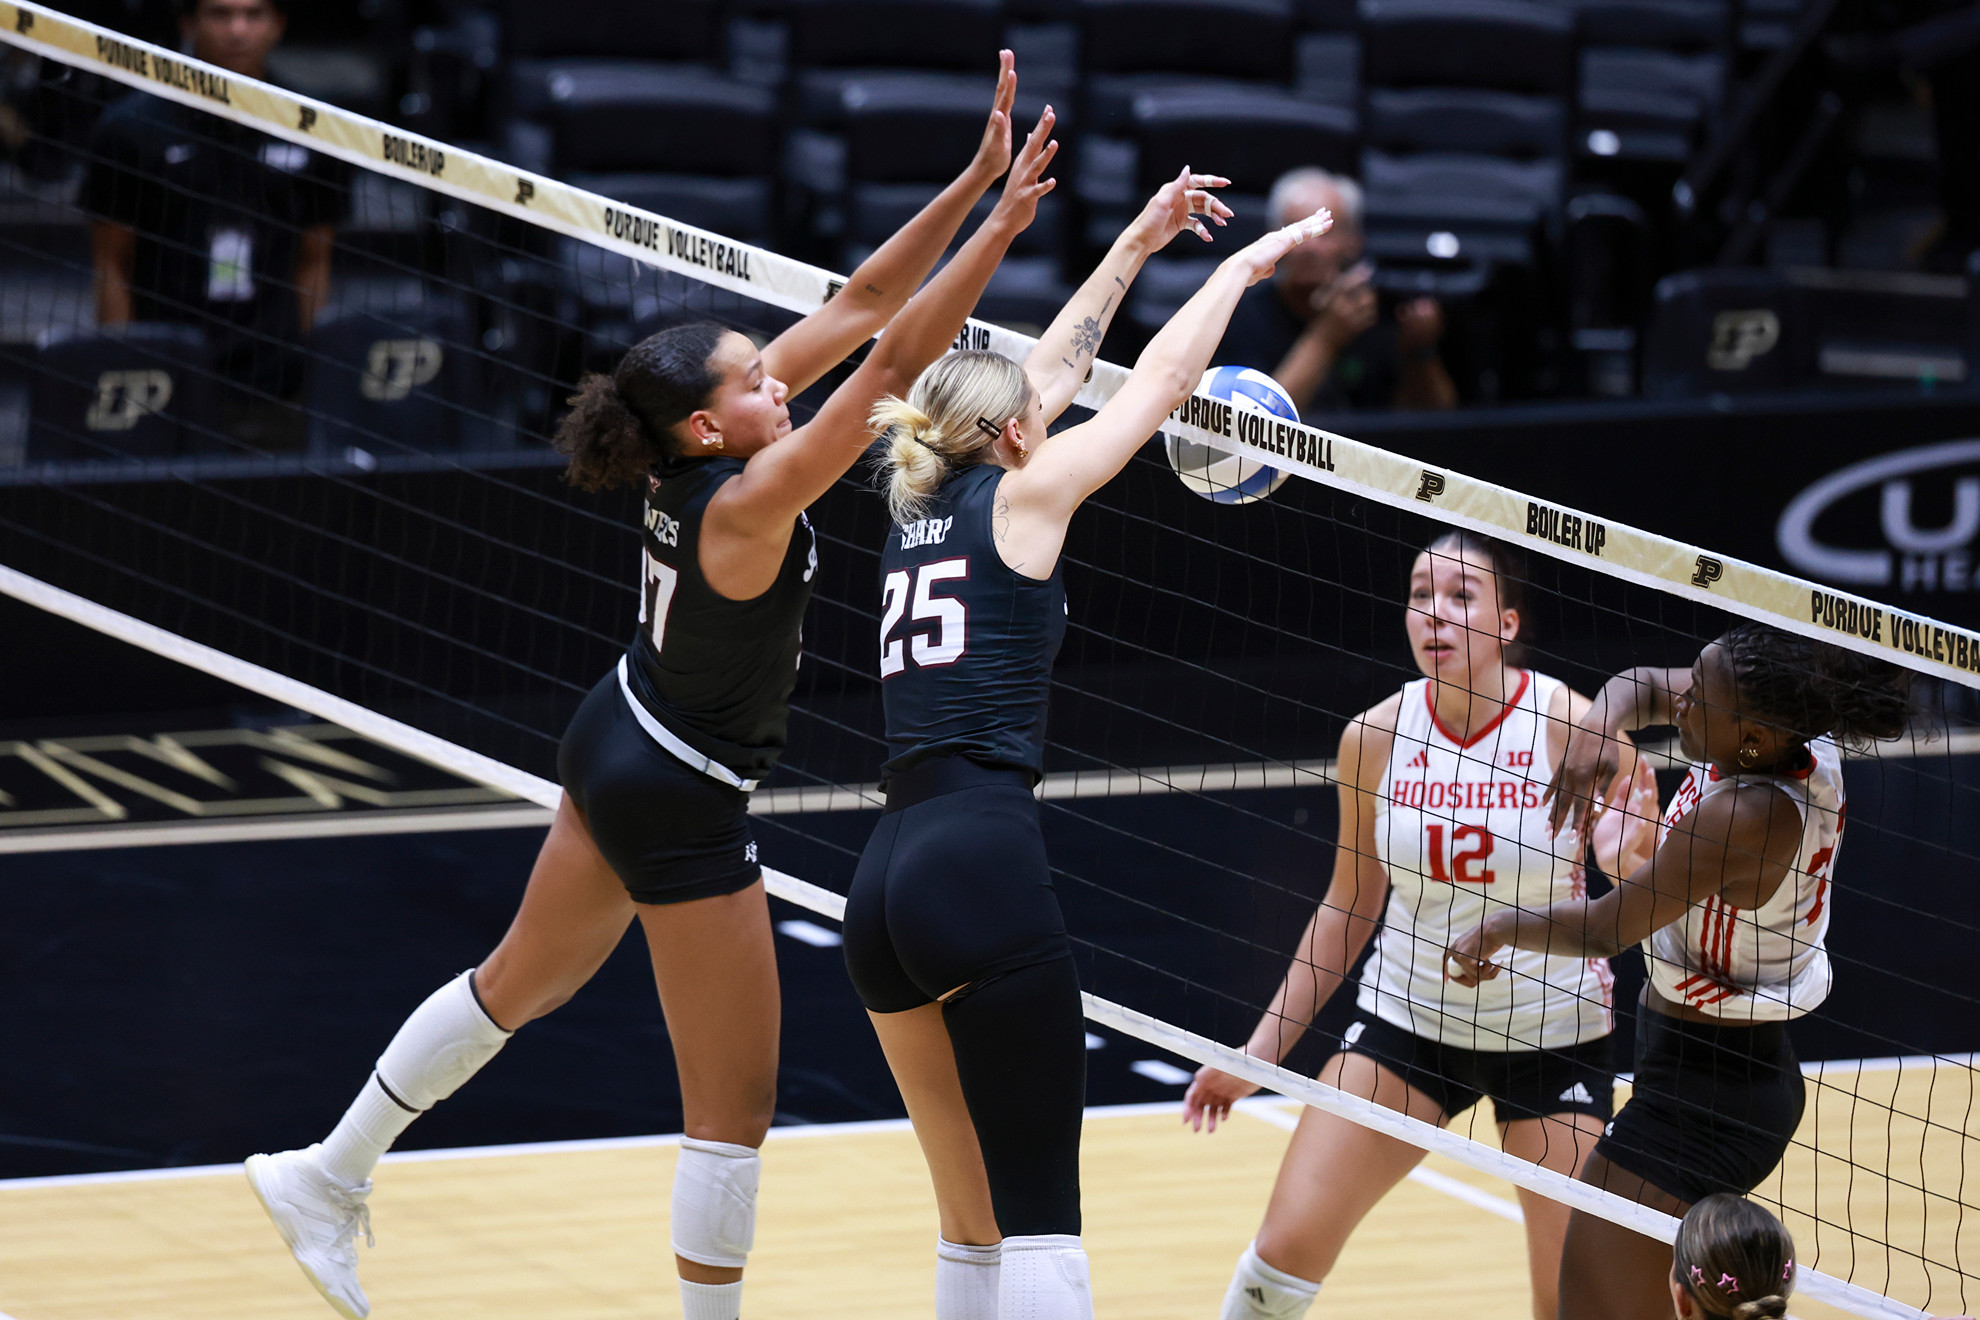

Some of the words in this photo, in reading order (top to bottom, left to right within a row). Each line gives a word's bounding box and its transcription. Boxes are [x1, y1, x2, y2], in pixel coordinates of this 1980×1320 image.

[383, 133, 428, 173] BOILER
[428, 148, 445, 177] UP
[605, 207, 660, 251] PURDUE
[667, 225, 751, 281] VOLLEYBALL
[1238, 410, 1335, 472] VOLLEYBALL
[1415, 469, 1446, 503] P
[1526, 502, 1582, 550] BOILER
[1585, 520, 1606, 556] UP
[1692, 554, 1723, 589] P
[880, 555, 970, 681] 25
[1811, 590, 1882, 642] PURDUE
[1392, 780, 1538, 809] HOOSIERS
[1426, 825, 1495, 884] 12
